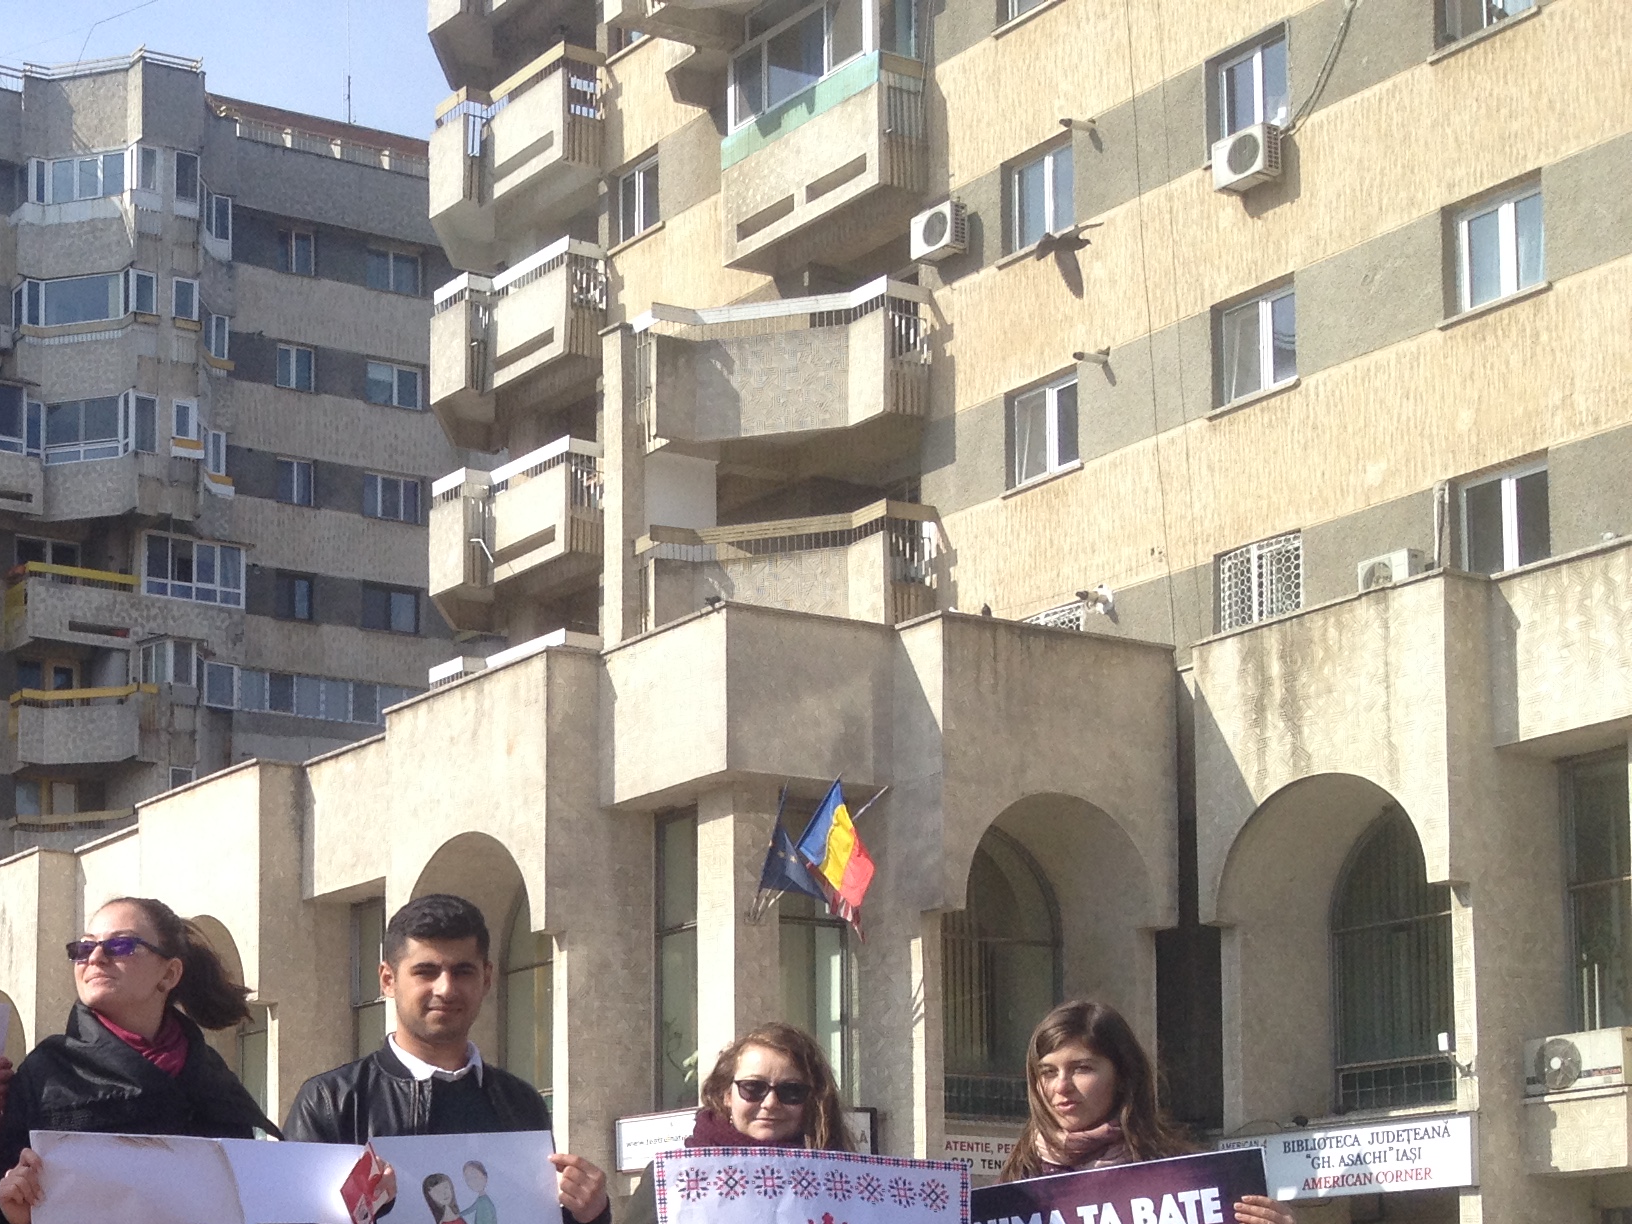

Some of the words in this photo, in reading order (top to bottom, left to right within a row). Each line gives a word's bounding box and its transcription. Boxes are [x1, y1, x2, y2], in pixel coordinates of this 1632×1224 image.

[945, 1140, 994, 1155] ATENTIE,
[1282, 1134, 1361, 1154] BIBLIOTECA
[1302, 1171, 1373, 1191] AMERICAN
[1375, 1167, 1433, 1184] CORNER
